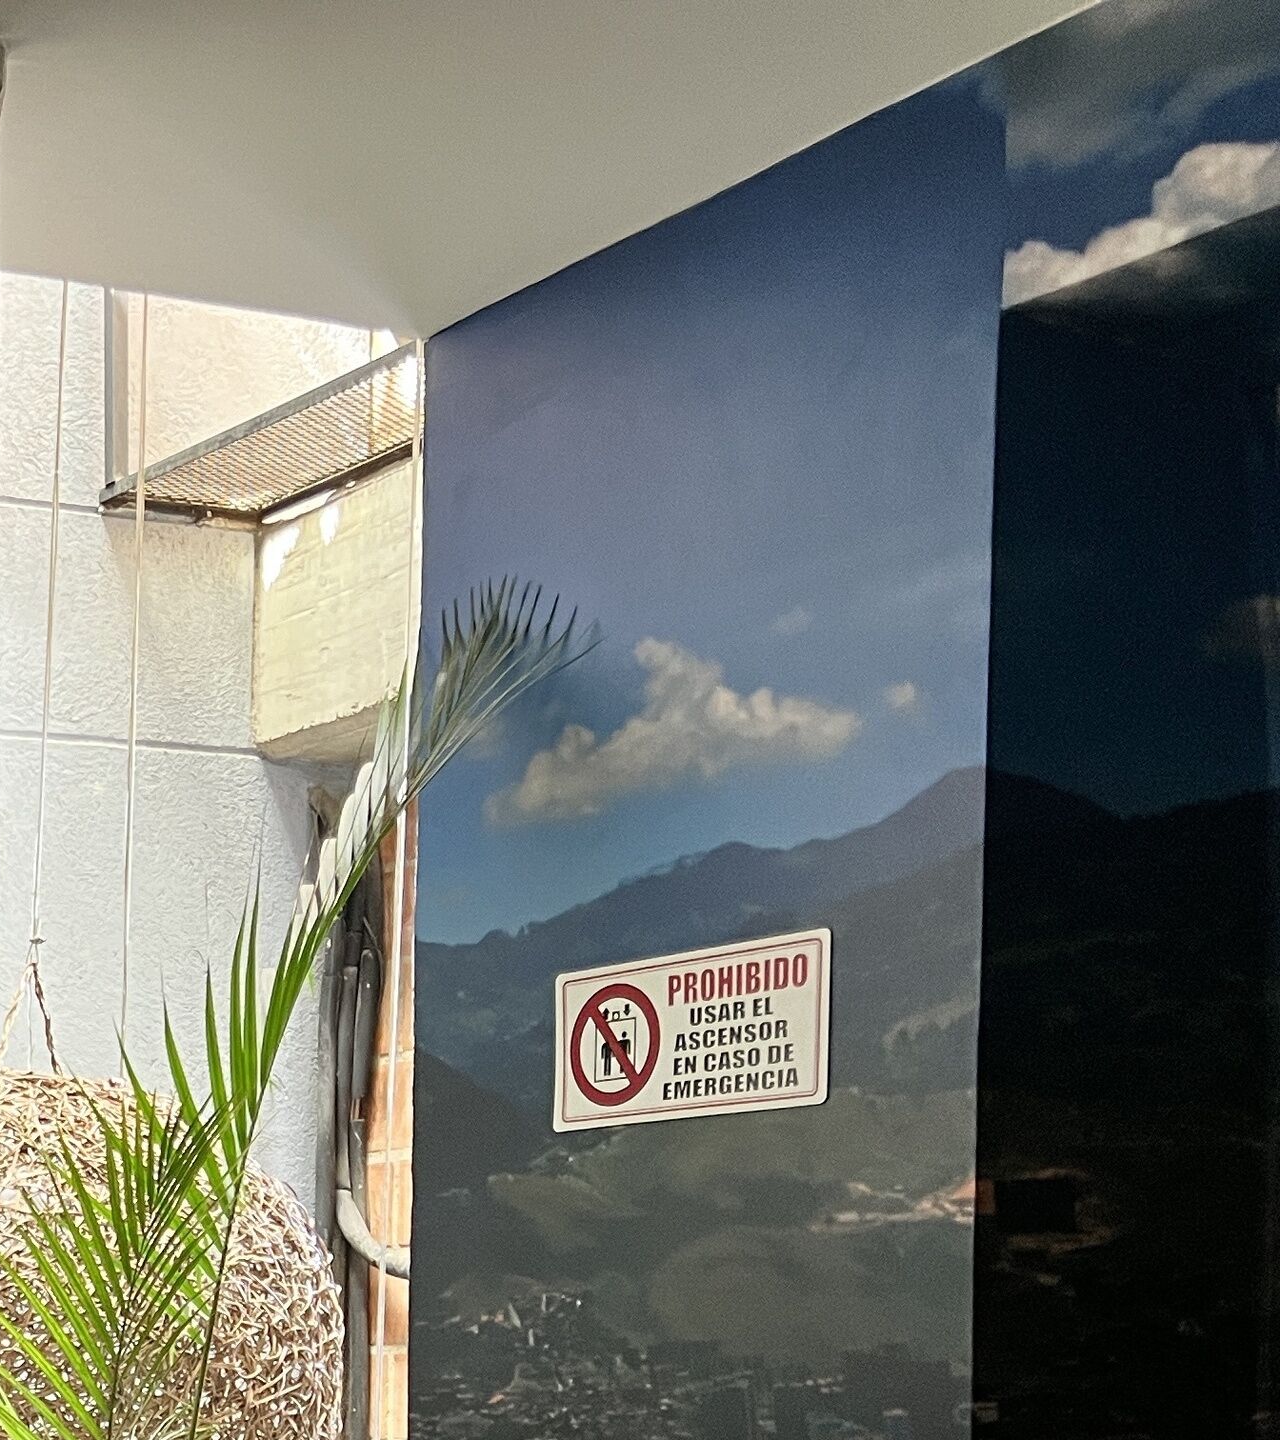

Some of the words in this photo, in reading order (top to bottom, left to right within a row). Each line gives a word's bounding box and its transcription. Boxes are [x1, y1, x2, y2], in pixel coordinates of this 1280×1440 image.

[667, 953, 809, 1007] PROHIBIDO
[689, 1001, 746, 1027] USAR
[752, 996, 775, 1018] EL
[673, 1019, 789, 1053] ASCENSOR
[672, 1055, 697, 1076] EN
[703, 1047, 761, 1073] CASO
[767, 1042, 795, 1065] DE
[662, 1067, 799, 1101] EMERGENCIA
